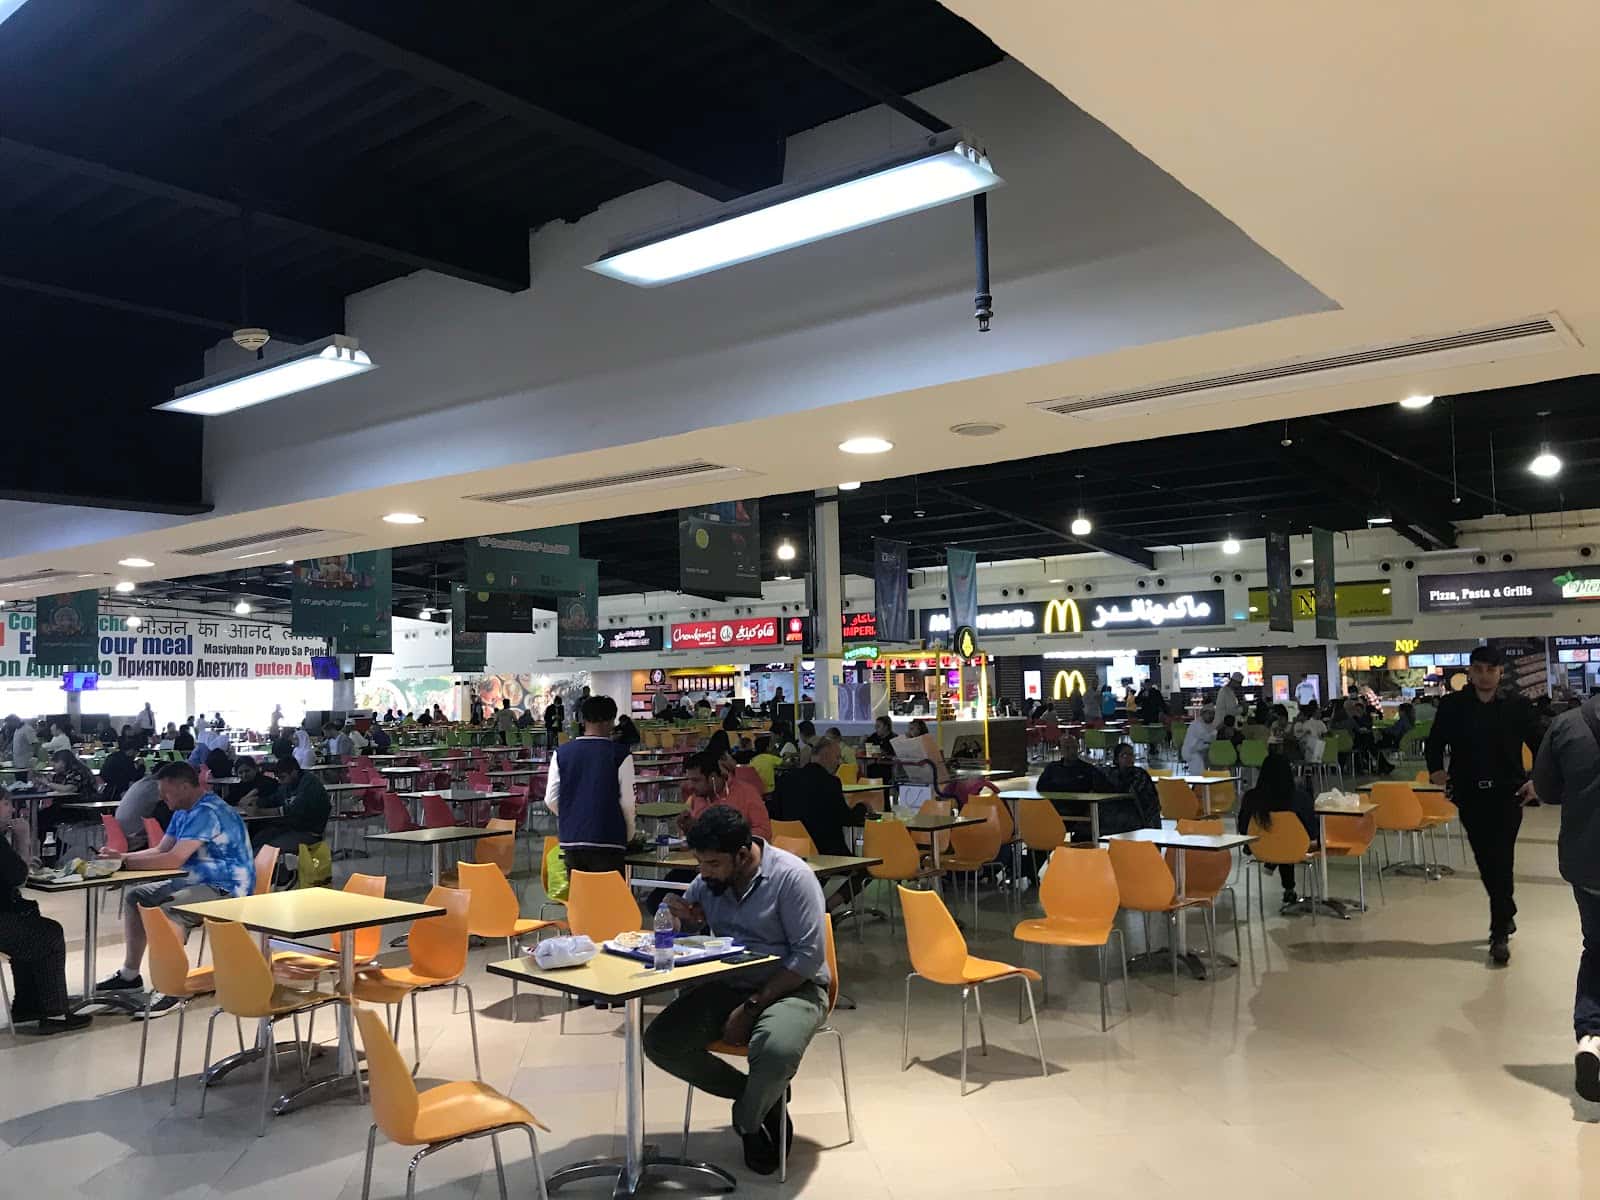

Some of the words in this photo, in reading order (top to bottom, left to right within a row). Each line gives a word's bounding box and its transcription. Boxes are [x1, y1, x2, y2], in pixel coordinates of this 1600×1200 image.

[1429, 589, 1460, 602] Pizza,
[1462, 588, 1491, 599] Pasta
[1493, 587, 1501, 597] &
[1503, 585, 1533, 597] Grills
[673, 627, 711, 643] Chowking
[98, 636, 138, 655] our
[142, 635, 193, 655] meal
[203, 643, 254, 656] Masiyahan
[256, 645, 266, 655] Po
[268, 645, 290, 657] Kayo
[292, 646, 302, 656] Sa
[0, 659, 20, 677] on
[118, 656, 194, 679] Приятново
[196, 659, 248, 678] Апетита
[255, 662, 292, 677] guten
